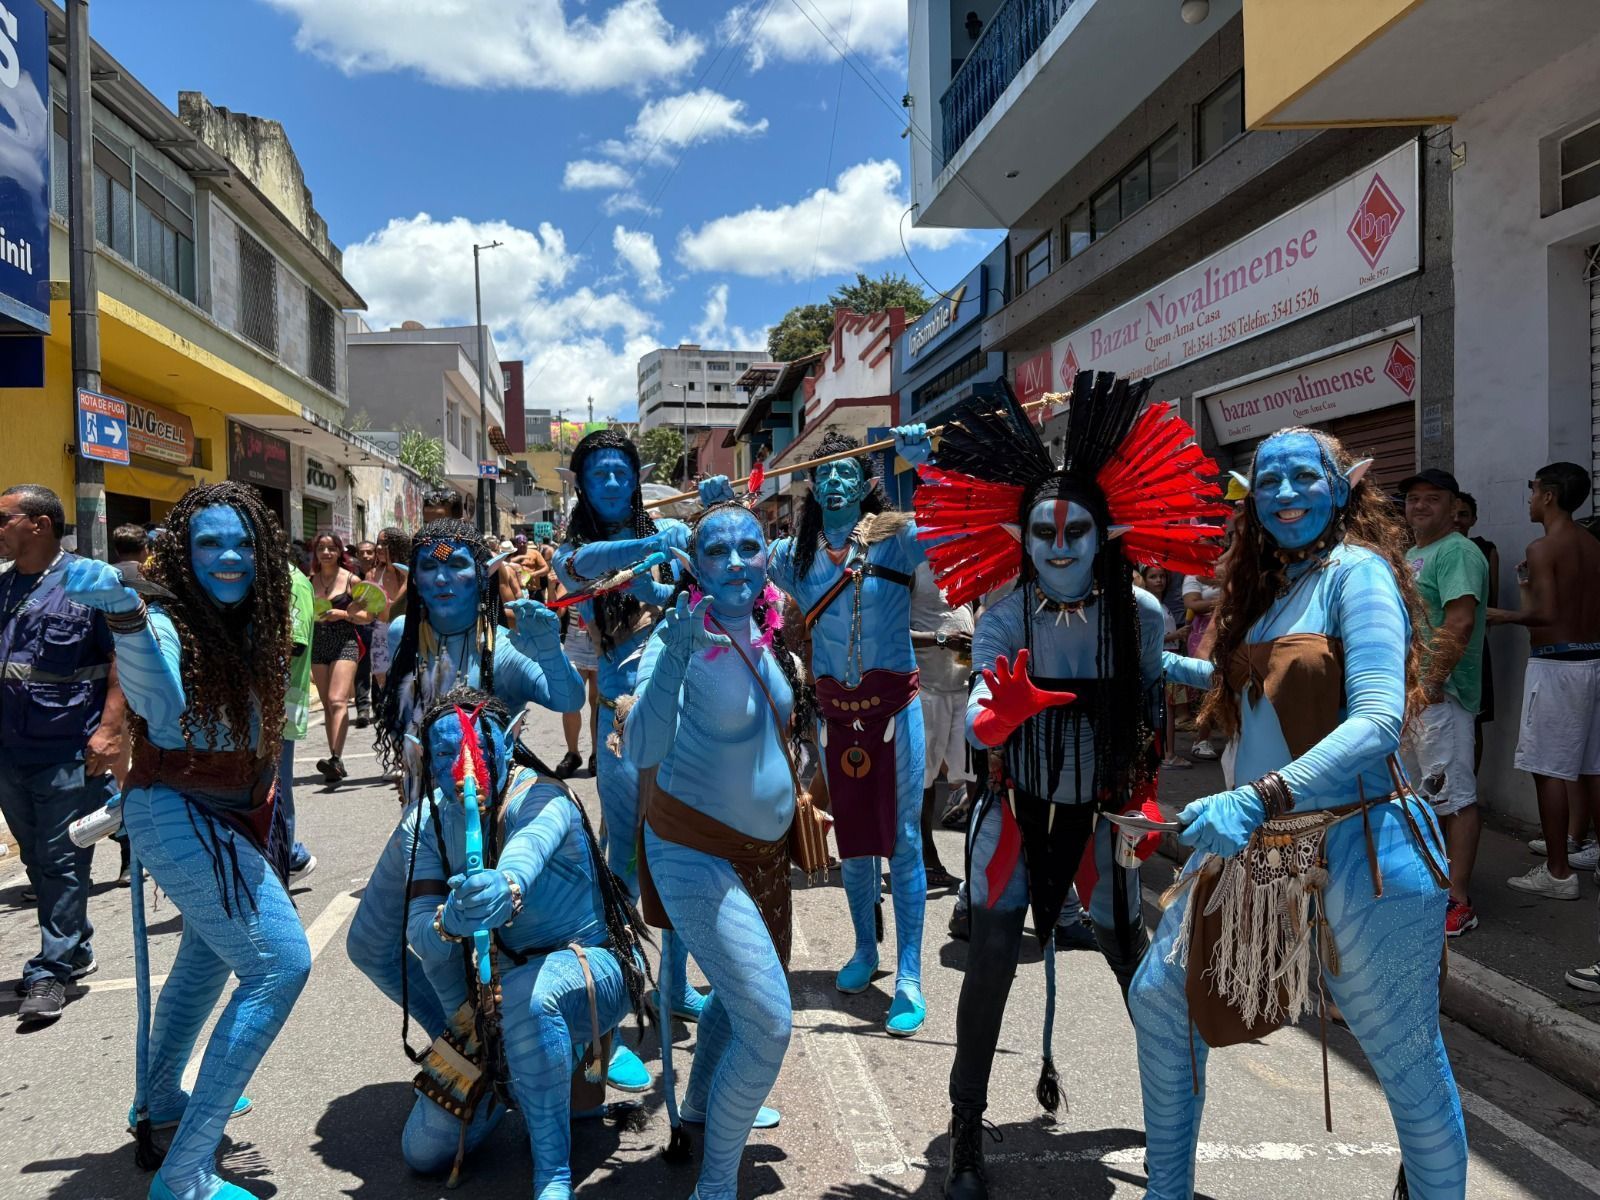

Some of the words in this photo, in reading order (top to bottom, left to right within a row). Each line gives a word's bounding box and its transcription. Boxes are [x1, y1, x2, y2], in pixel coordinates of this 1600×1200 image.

[1359, 202, 1392, 242] bn
[1089, 318, 1142, 362] Bazar
[1144, 229, 1318, 336] Novalimense
[1145, 332, 1171, 352] Quem
[1173, 321, 1195, 340] Ama
[1196, 309, 1221, 328] Casa
[1237, 310, 1270, 334] Telefax:
[80, 393, 98, 408] ROTA
[98, 398, 107, 410] DE
[108, 401, 125, 415] FUGA
[1219, 397, 1261, 422] bazar
[1263, 365, 1375, 410] novalimense
